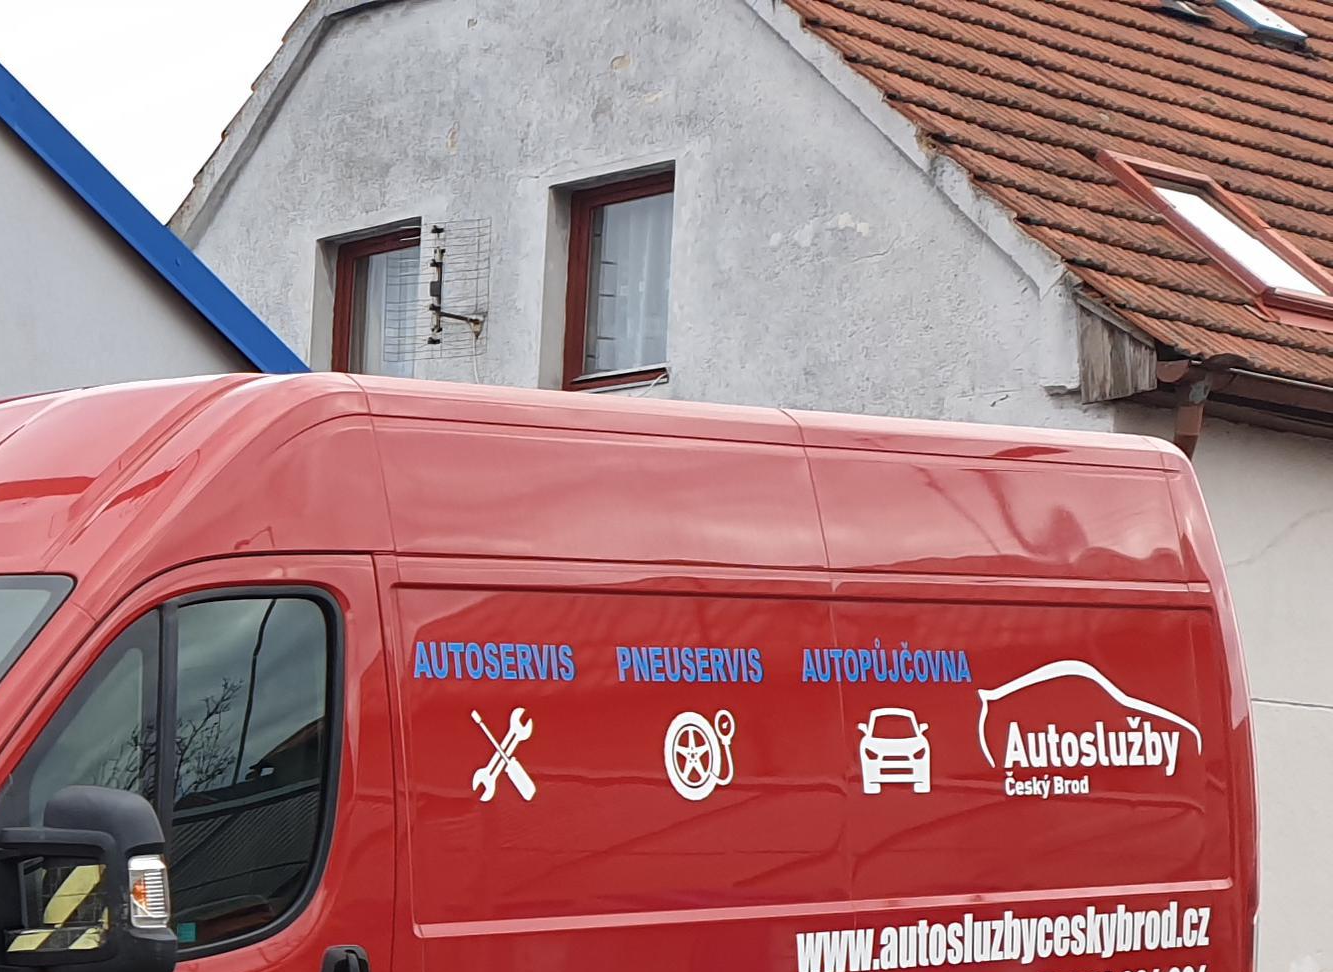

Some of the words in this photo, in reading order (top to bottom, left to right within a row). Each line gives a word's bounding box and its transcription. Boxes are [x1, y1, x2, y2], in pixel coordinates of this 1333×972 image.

[413, 641, 575, 681] AUTOSERVIS
[615, 646, 764, 683] PNEUSERVIS
[802, 637, 972, 683] AUTOPŮJČOVNA
[1004, 717, 1180, 776] Autoslužby
[1004, 771, 1051, 799] Český
[1053, 775, 1089, 795] Brod
